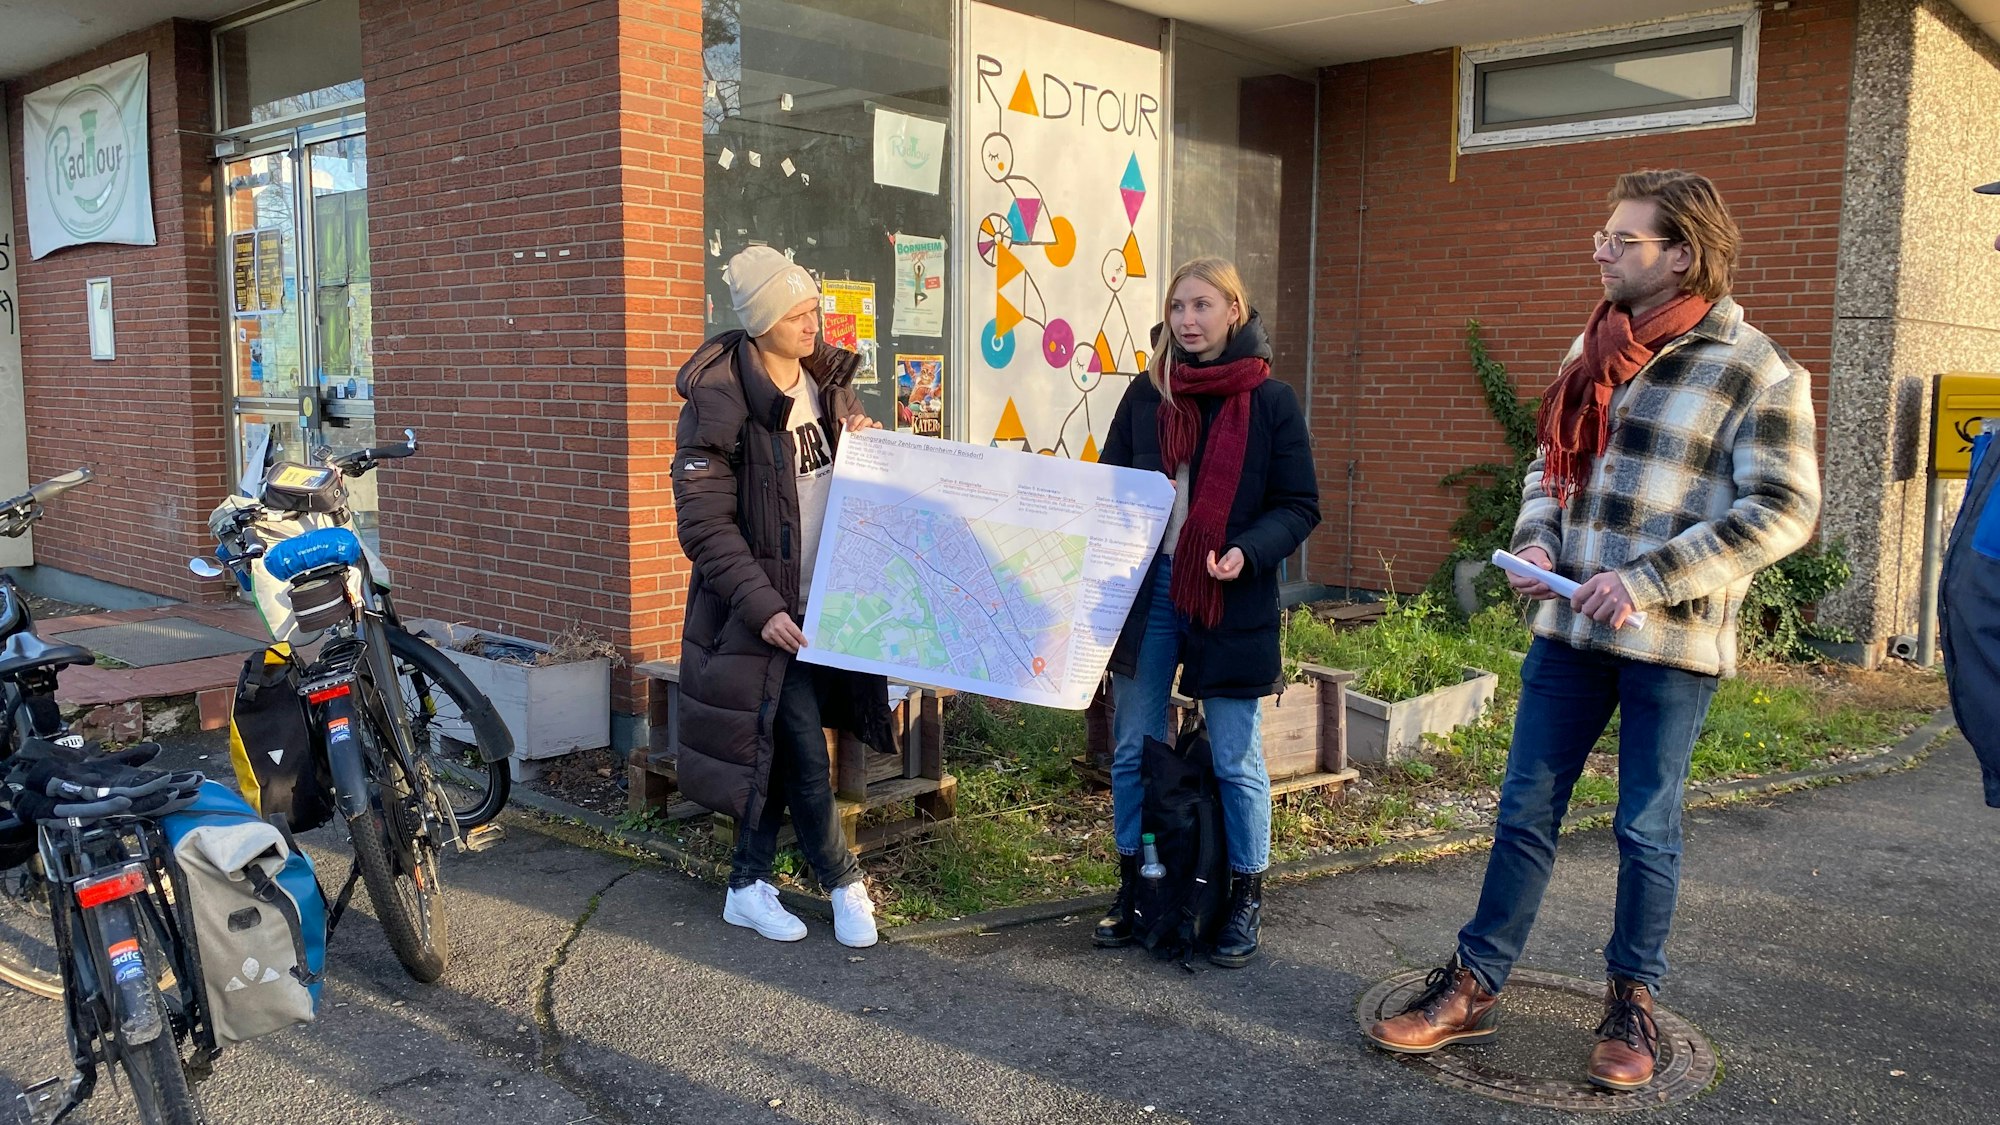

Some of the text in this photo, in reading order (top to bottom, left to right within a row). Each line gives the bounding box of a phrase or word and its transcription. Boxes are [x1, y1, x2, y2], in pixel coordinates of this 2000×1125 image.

[976, 53, 1158, 140] RADTOUR
[896, 242, 942, 255] BORNHEIM
[824, 314, 849, 329] Circus
[831, 323, 855, 342] Aladin
[913, 416, 939, 434] KATER
[850, 432, 897, 447] Planungsradtour
[898, 439, 923, 451] Zentrum
[923, 444, 953, 456] (Bornheim
[957, 449, 984, 460] Roisdorf)
[330, 724, 350, 734] adfc
[112, 951, 140, 967] adfc
